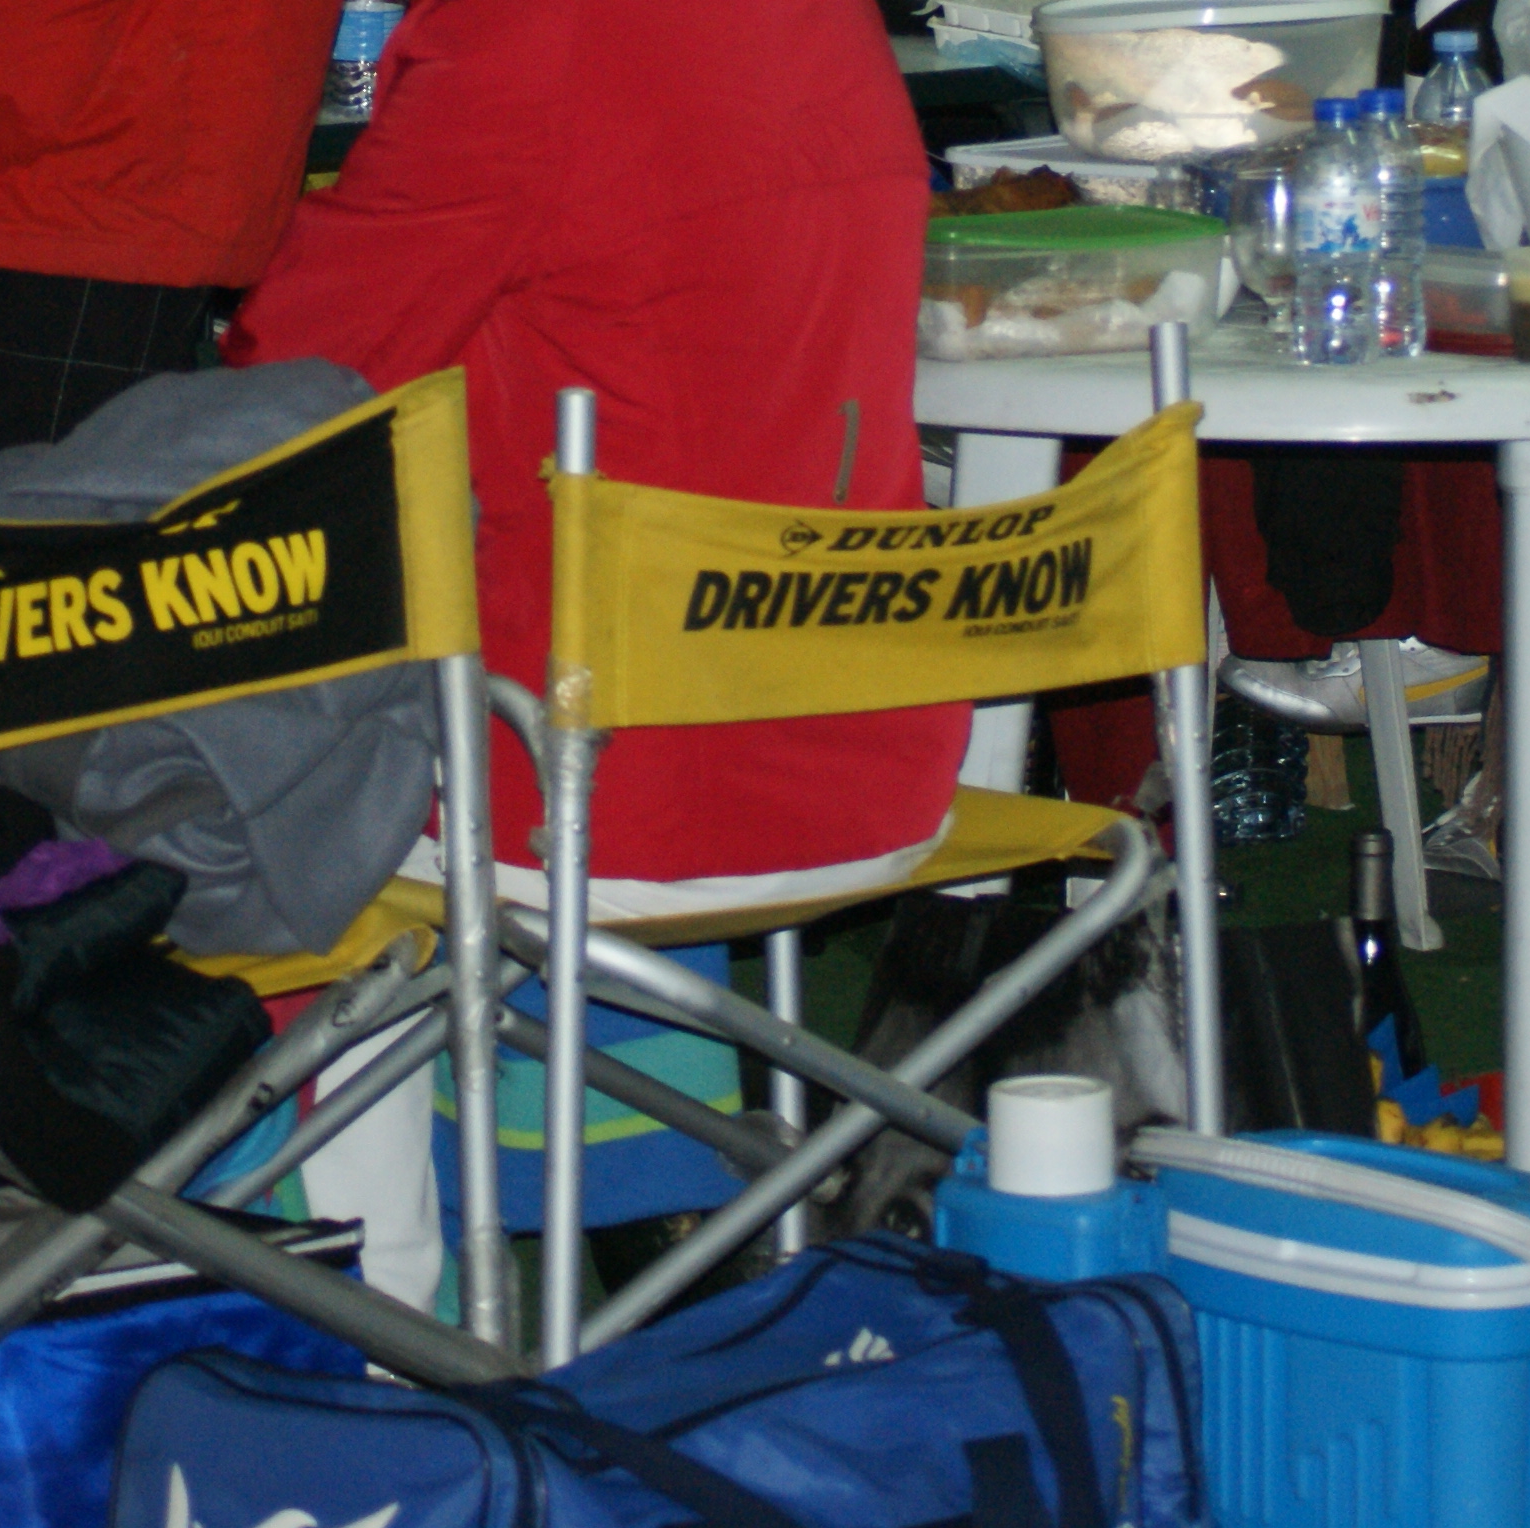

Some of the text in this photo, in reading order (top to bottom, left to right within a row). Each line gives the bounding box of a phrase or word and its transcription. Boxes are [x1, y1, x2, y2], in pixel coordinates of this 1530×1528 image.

[828, 504, 1055, 551] DUNLOP
[141, 529, 327, 631] KNOW
[683, 537, 1093, 632] DRIVERS KNOW
